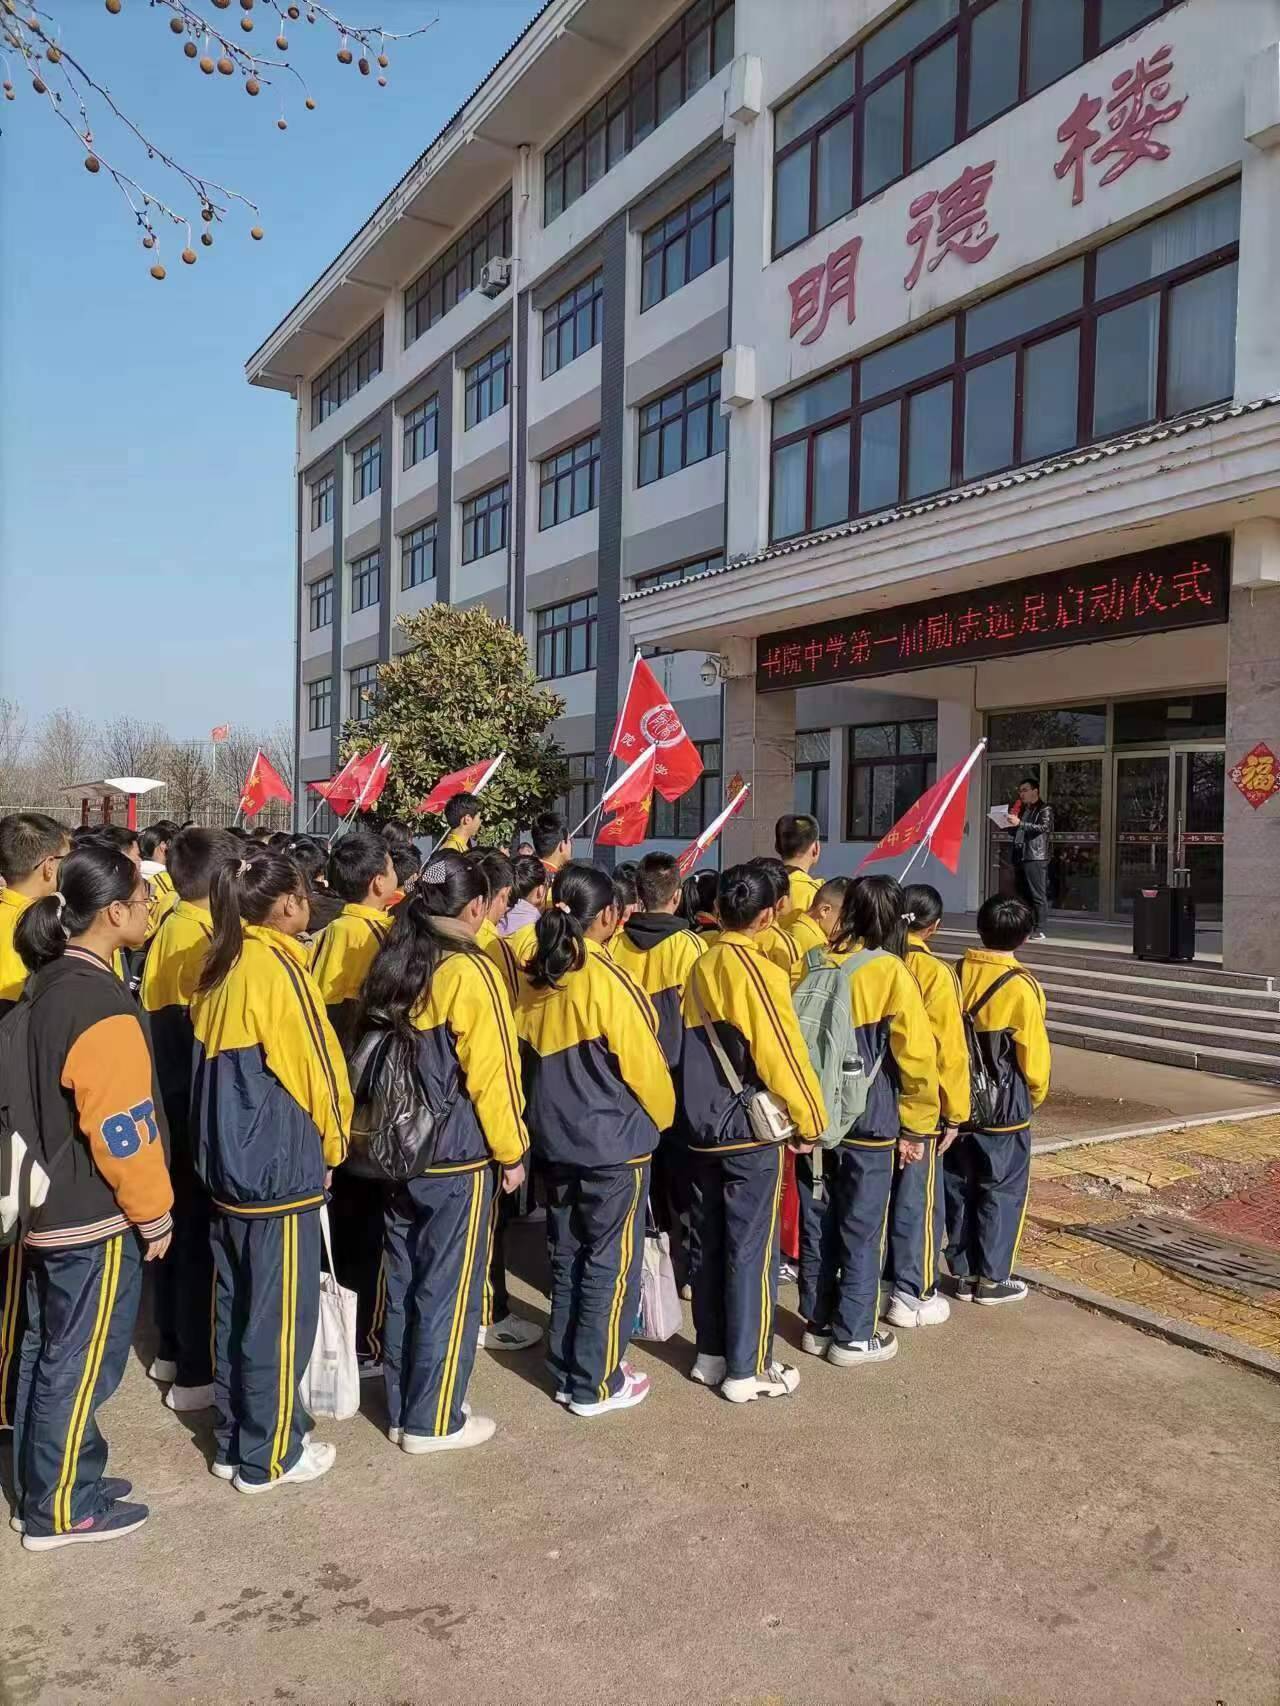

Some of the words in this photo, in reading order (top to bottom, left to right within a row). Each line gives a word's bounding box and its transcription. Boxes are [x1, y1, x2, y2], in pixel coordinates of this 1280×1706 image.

[787, 44, 1189, 346] 明德楼
[1241, 754, 1275, 791] 福
[100, 1096, 158, 1160] 87
